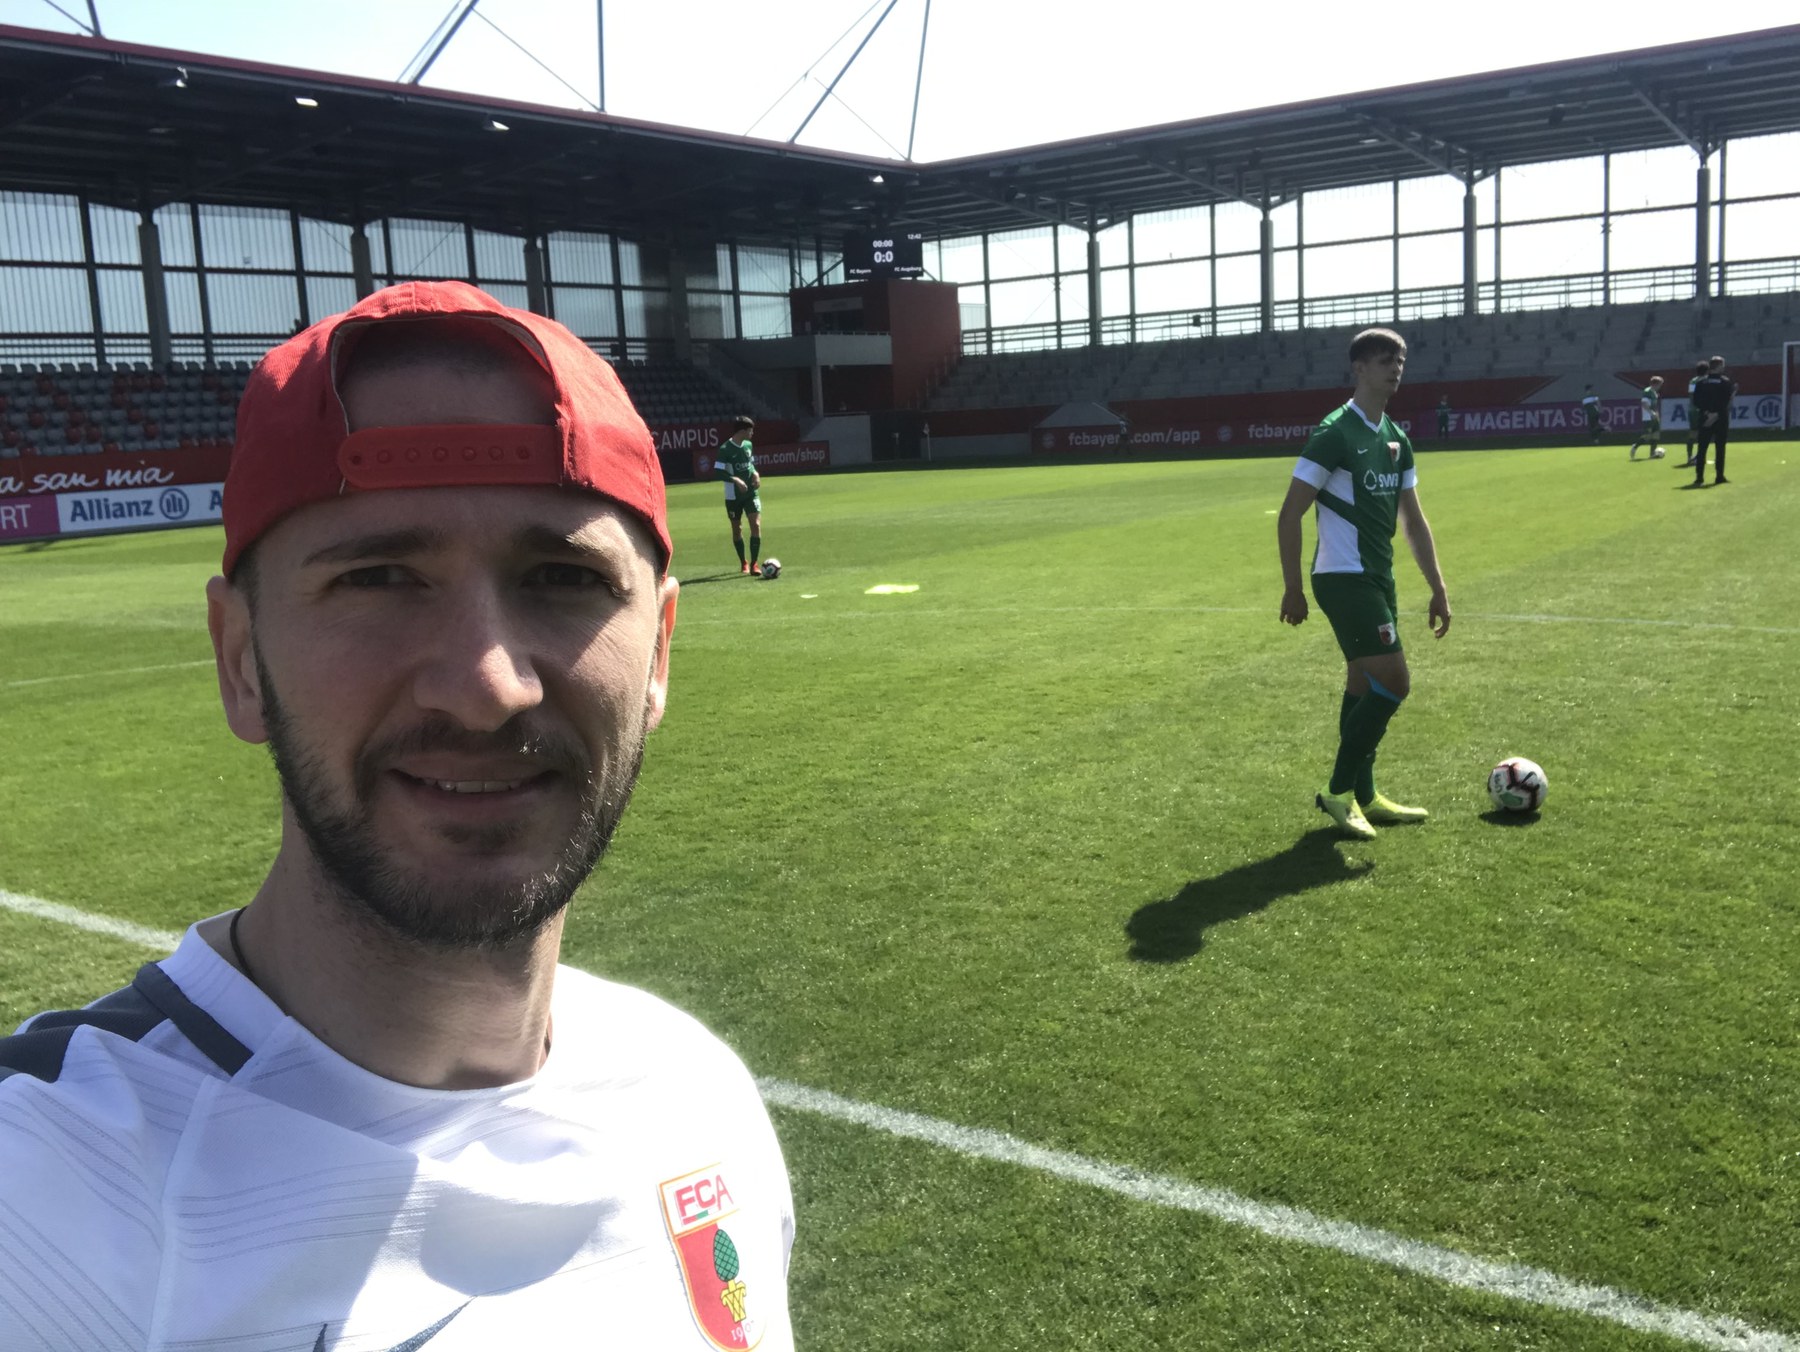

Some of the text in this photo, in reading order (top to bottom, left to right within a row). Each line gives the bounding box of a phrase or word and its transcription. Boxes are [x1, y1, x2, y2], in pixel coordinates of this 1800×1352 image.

[872, 240, 894, 248] 00:00
[873, 251, 894, 263] 0:0
[1464, 405, 1640, 431] MAGENTA SORT
[1068, 427, 1201, 447] fcbayer.com/app
[753, 446, 826, 466] ern.com/shop
[28, 472, 99, 494] san
[105, 459, 175, 487] mia
[70, 497, 154, 523] Allianz
[674, 1174, 734, 1217] FCA
[730, 1320, 754, 1343] 190
